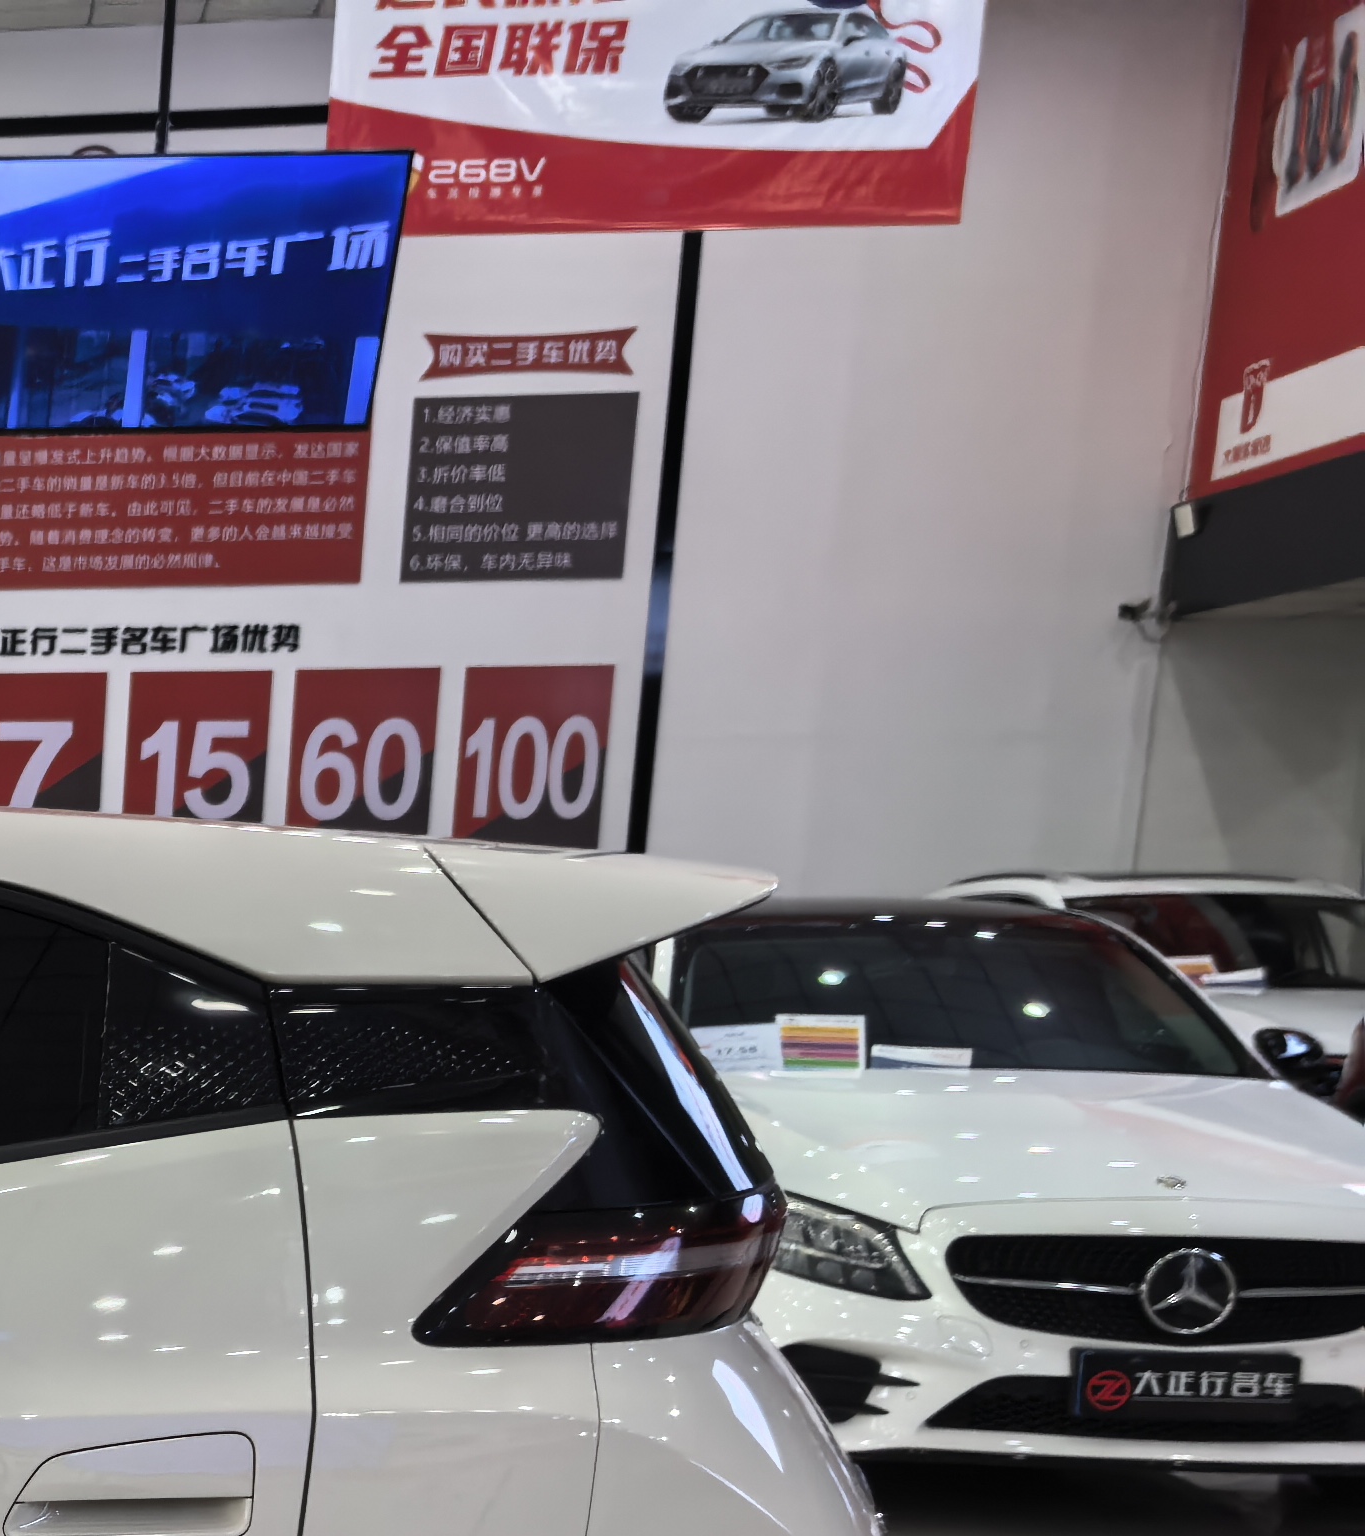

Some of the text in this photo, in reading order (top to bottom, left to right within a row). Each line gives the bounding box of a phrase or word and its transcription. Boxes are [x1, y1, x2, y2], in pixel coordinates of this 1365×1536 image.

[369, 18, 630, 79] 全国联保
[428, 156, 547, 184] 268V
[438, 339, 617, 367] 购买二手车优势
[140, 719, 252, 821] 15
[299, 716, 423, 822] 60
[465, 714, 601, 822] 100
[1133, 1370, 1294, 1397] 大正行名车
